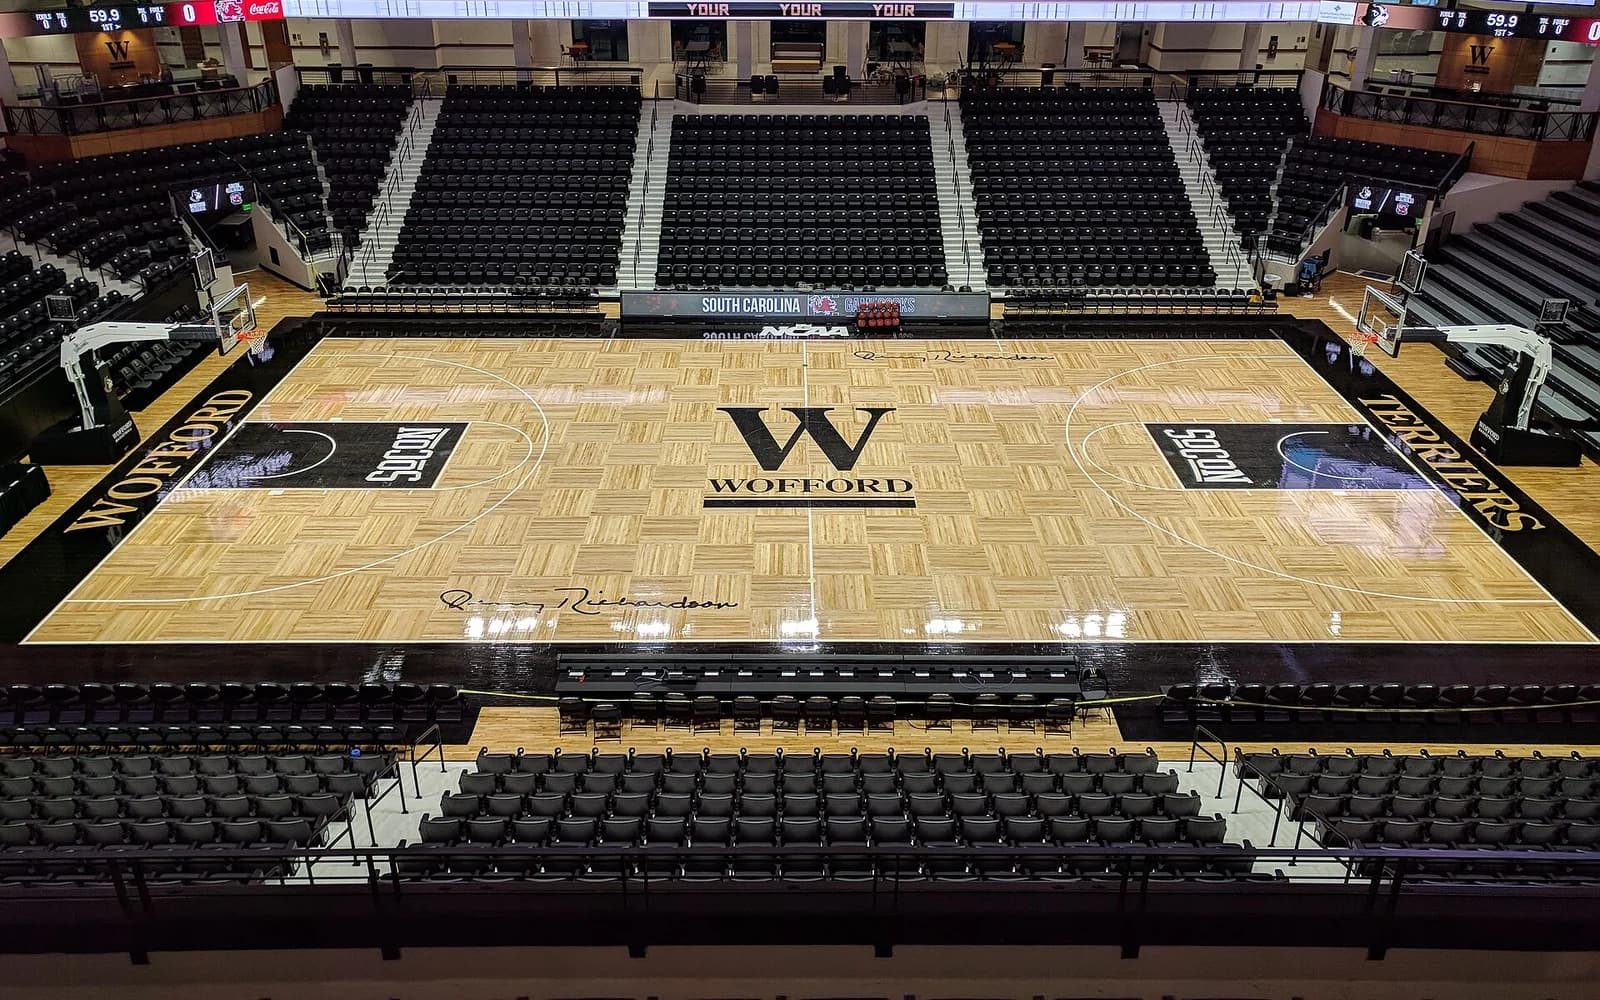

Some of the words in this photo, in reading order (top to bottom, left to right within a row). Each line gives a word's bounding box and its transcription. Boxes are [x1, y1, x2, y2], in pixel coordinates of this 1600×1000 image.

[89, 9, 120, 22] 59.9
[183, 4, 196, 22] 0
[687, 4, 729, 15] YOUR
[780, 4, 822, 16] YOUR
[872, 4, 915, 17] YOUR
[43, 19, 50, 29] 0
[60, 18, 67, 28] 0
[141, 13, 148, 23] 0
[155, 12, 162, 21] 0
[1442, 17, 1449, 26] 0
[1458, 18, 1465, 28] 0
[1487, 13, 1518, 27] 59.9
[1538, 24, 1546, 34] 0
[1555, 25, 1563, 35] 0
[1588, 21, 1600, 41] 0
[104, 41, 130, 60] W
[1470, 45, 1495, 65] W
[702, 298, 739, 313] SOUTH
[743, 298, 800, 313] CAROLINA
[759, 323, 850, 338] NCAA
[715, 406, 897, 472] W
[64, 389, 254, 534] WOFFORD
[364, 426, 443, 482] SOCON
[1163, 428, 1255, 484] SOCON
[1358, 393, 1547, 532] TERRIERS
[708, 478, 914, 494] WOFFORD
